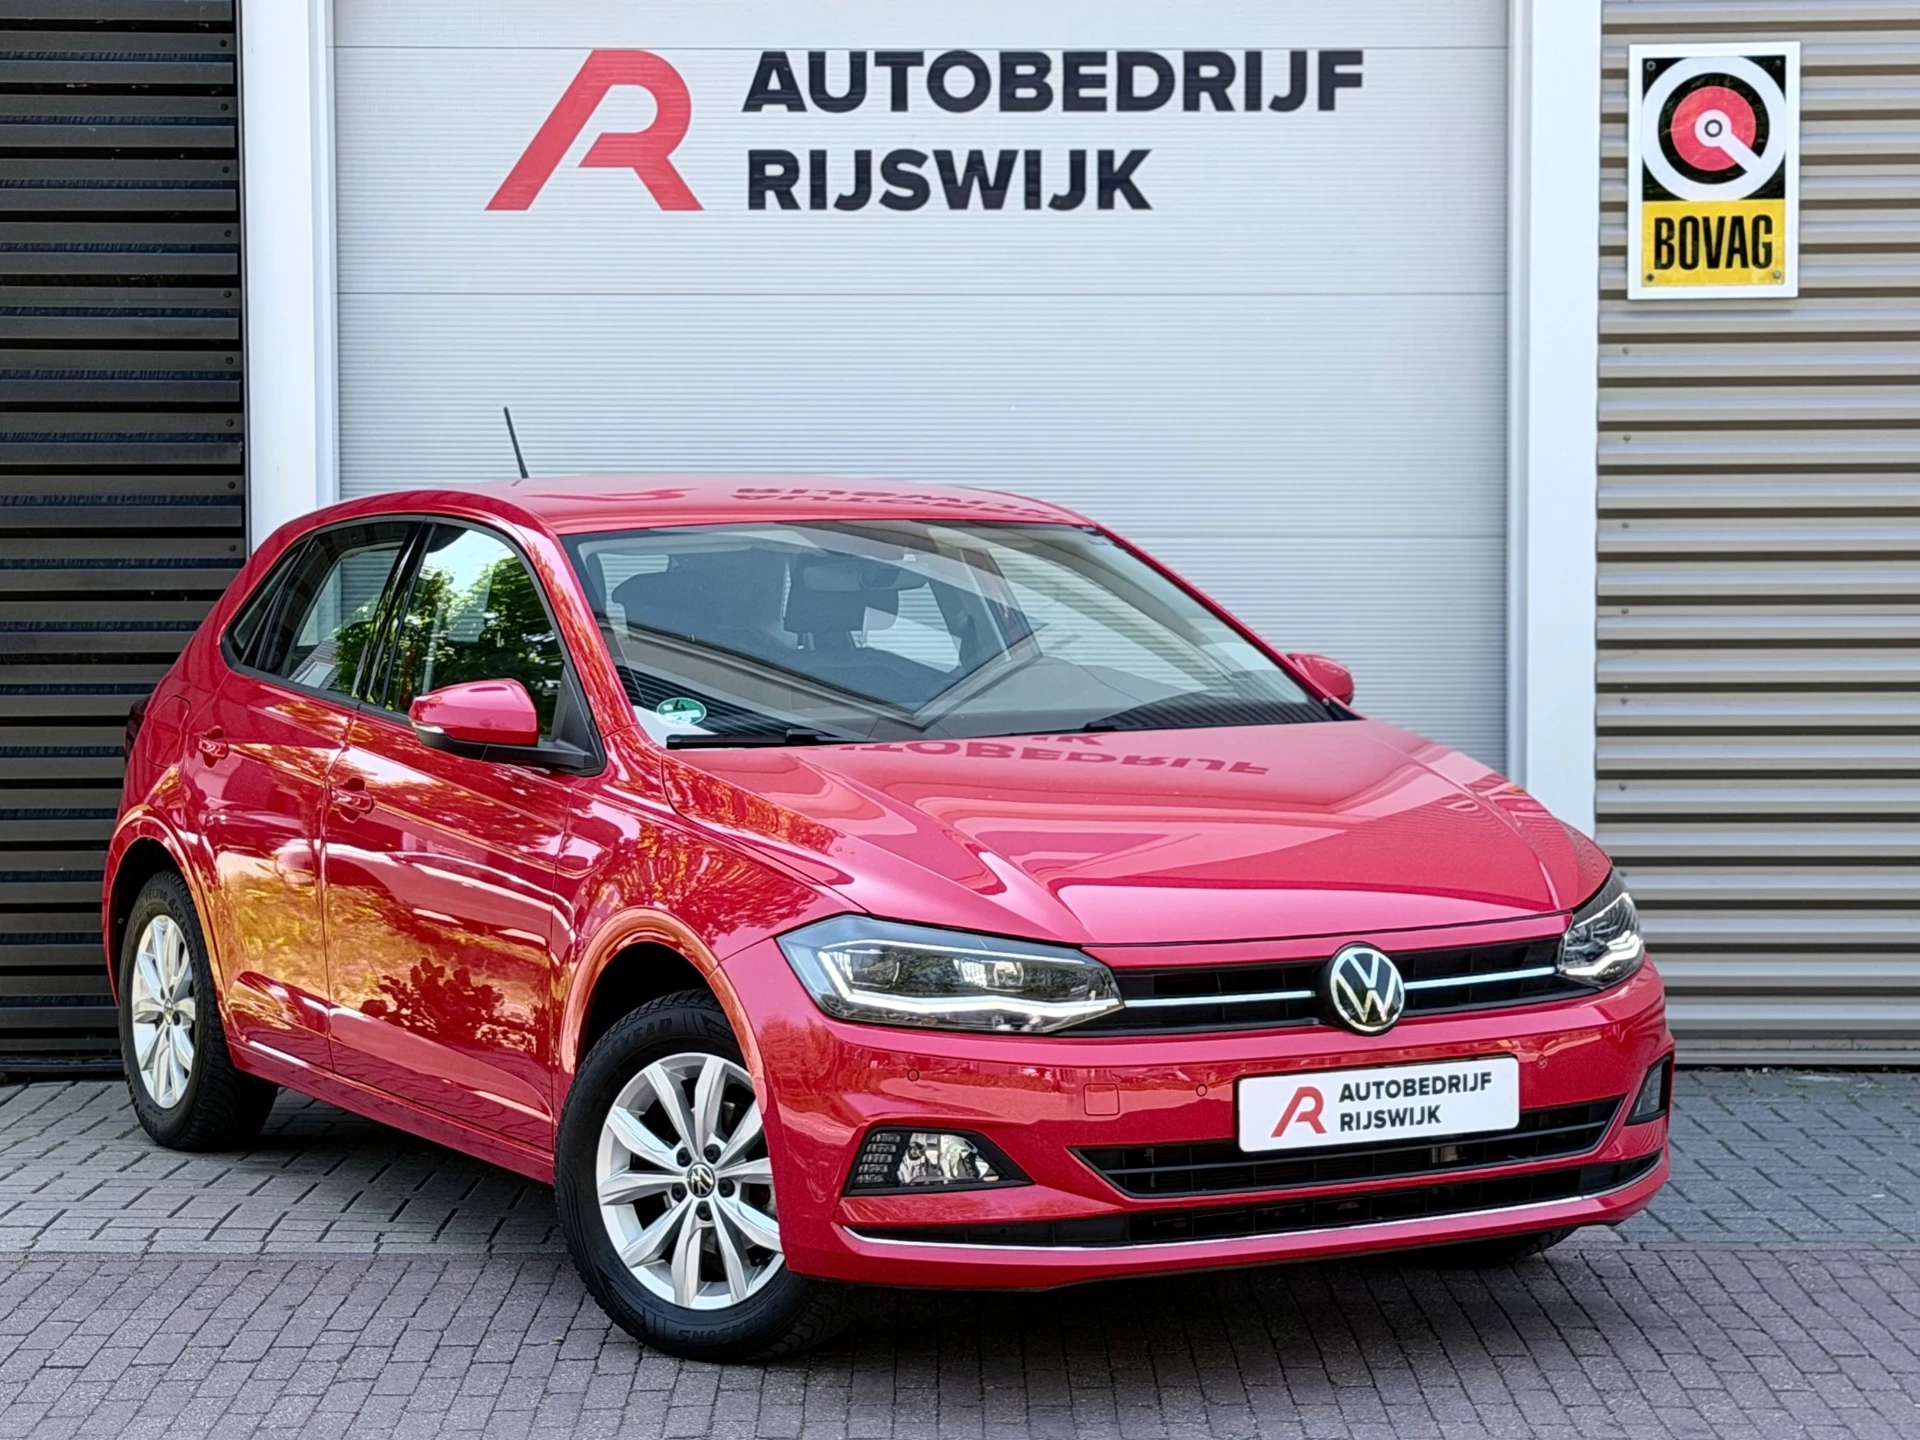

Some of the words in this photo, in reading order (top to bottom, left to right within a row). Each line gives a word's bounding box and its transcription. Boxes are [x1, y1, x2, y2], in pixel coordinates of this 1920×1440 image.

[743, 50, 1363, 113] AUTOBEDRIJF
[747, 149, 1153, 211] RIJSWIJK
[1654, 214, 1774, 270] BOVAG
[1339, 1071, 1492, 1102] AUTOBEDRIJF
[1340, 1104, 1441, 1132] RIJSWIJK
